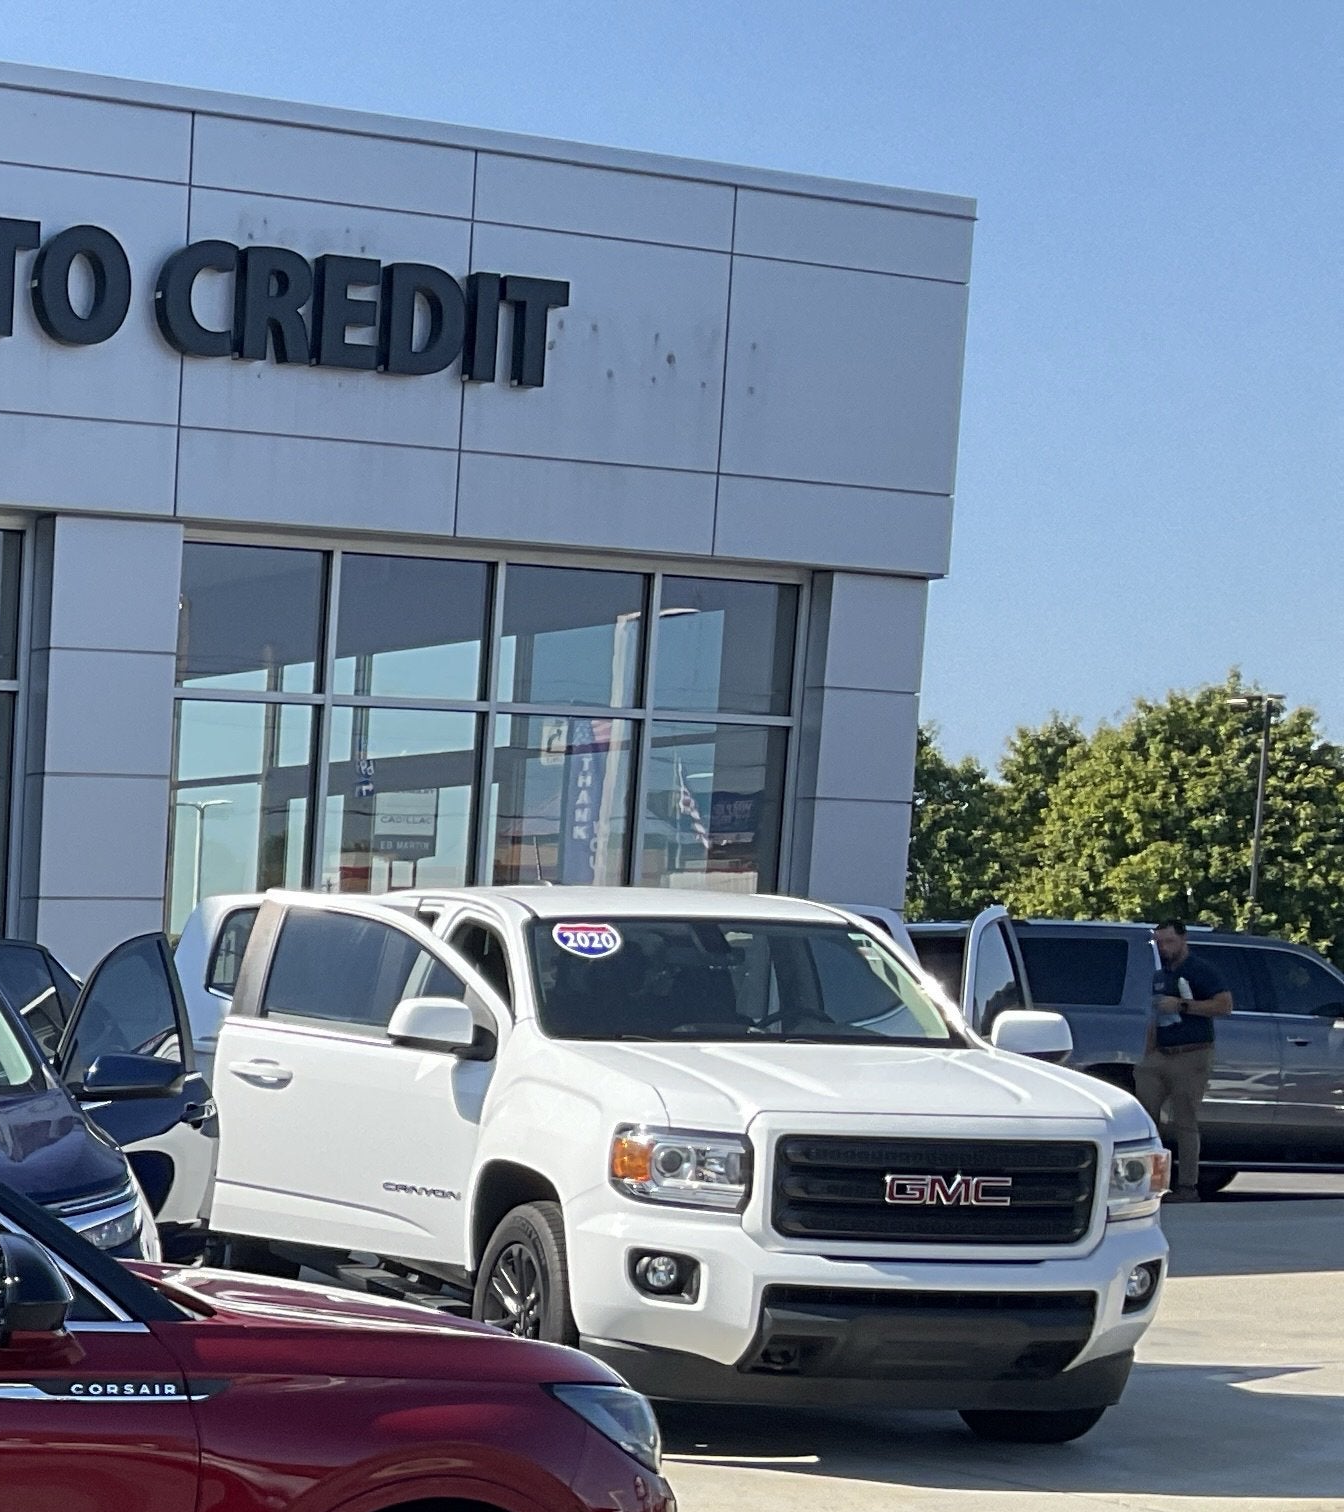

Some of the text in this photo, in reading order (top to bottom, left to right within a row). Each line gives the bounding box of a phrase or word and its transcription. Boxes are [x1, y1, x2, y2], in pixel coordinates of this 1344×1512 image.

[156, 239, 570, 388] CREDIT
[572, 757, 593, 840] THANK
[379, 814, 433, 825] CADILLAC
[562, 931, 615, 949] 2020
[382, 1181, 462, 1201] CANYON
[885, 1174, 1012, 1206] GMC
[70, 1383, 177, 1395] CORSAIR
